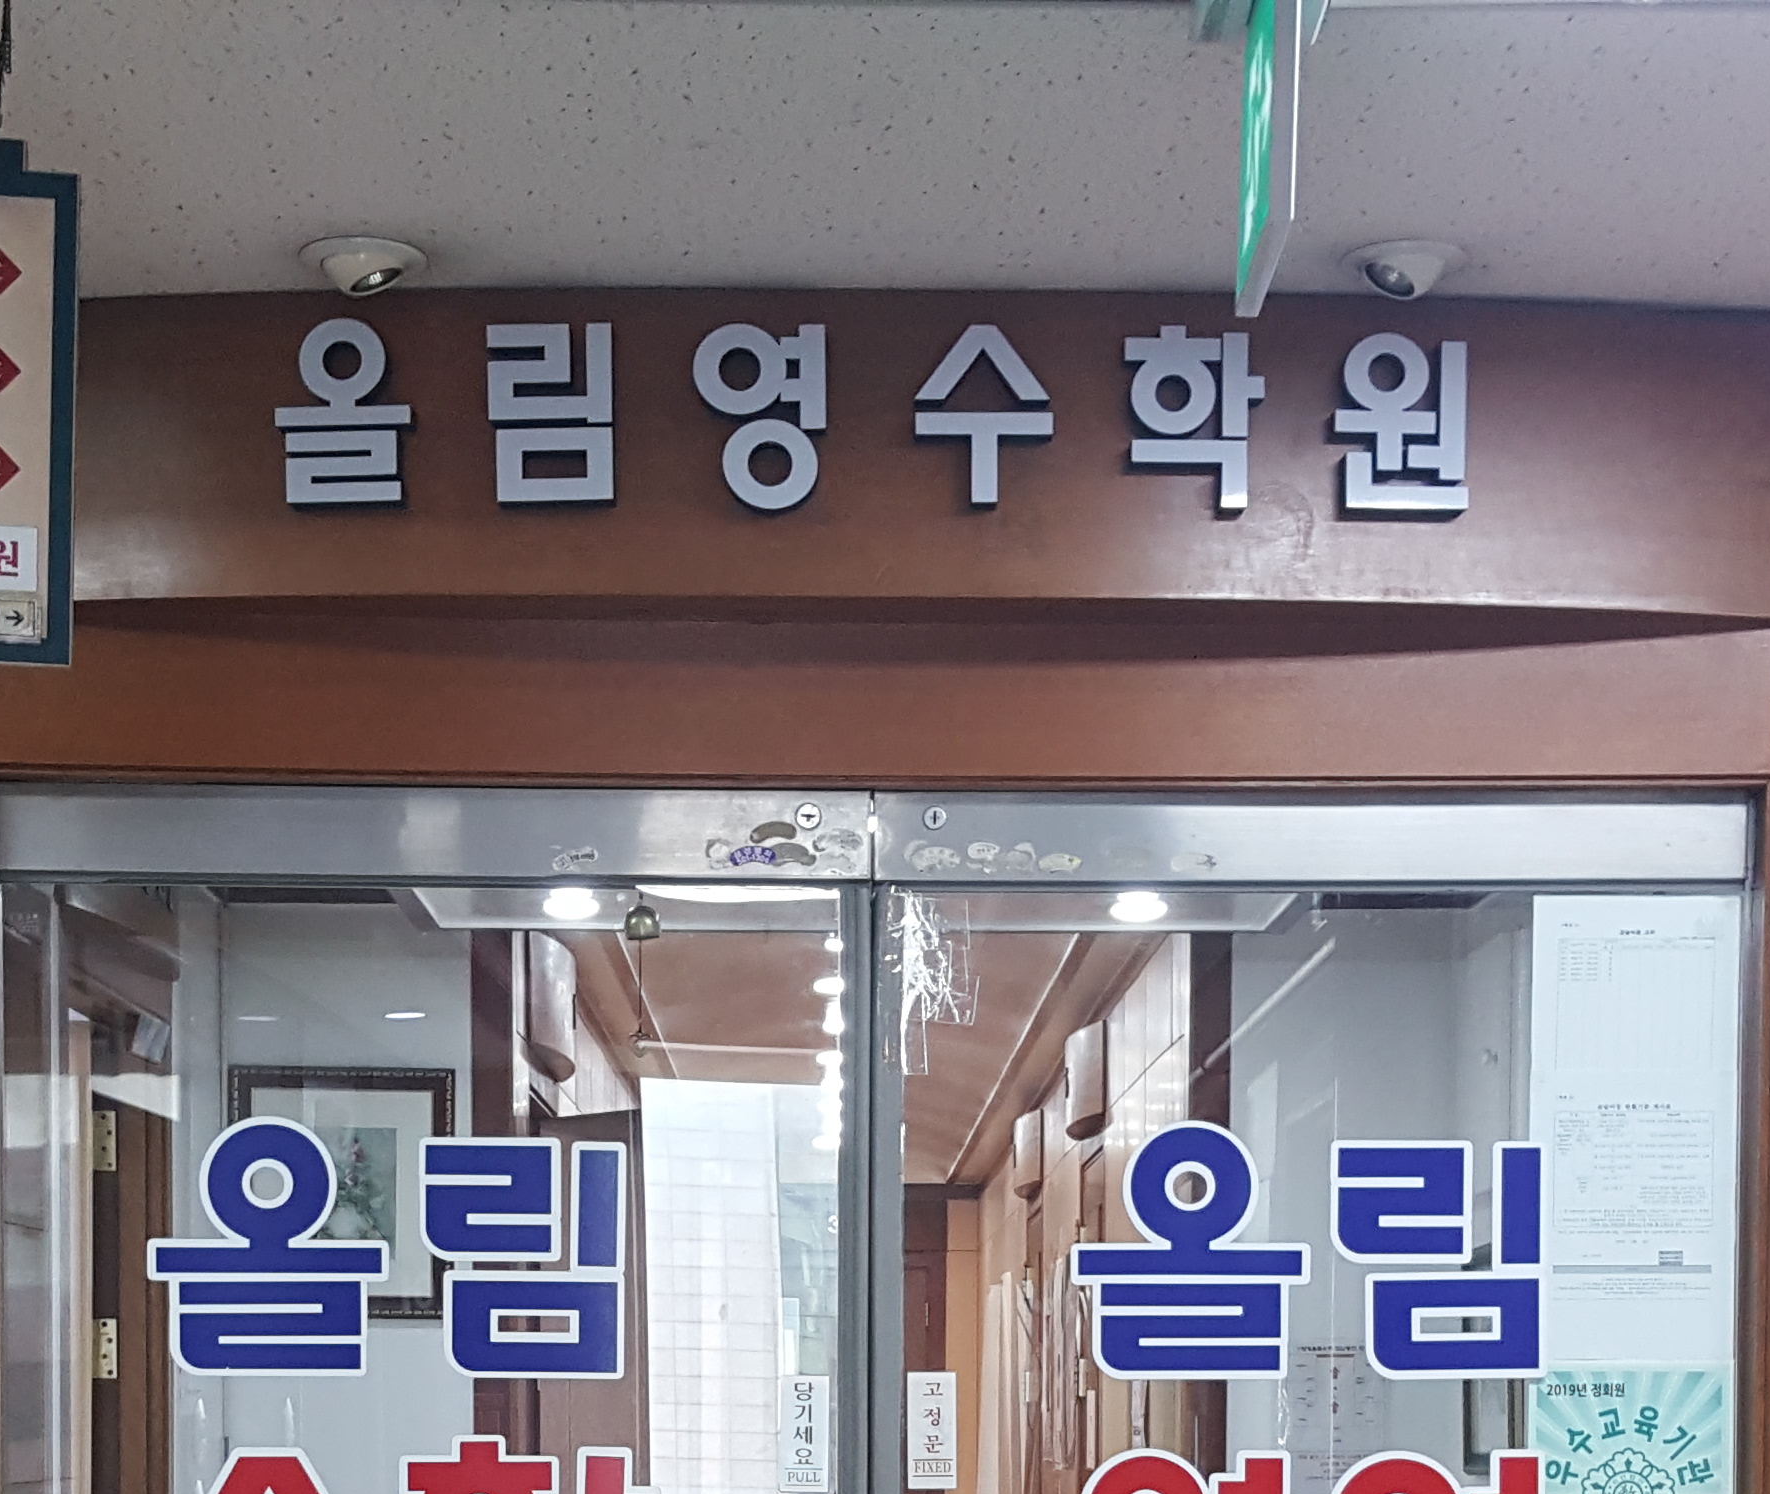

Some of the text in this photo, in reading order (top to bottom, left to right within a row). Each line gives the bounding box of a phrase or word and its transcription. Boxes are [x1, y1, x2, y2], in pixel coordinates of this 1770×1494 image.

[274, 318, 1469, 514] 올림영수학원
[147, 1115, 628, 1380] 올림
[1071, 1120, 1548, 1381] 올림
[793, 1382, 815, 1465] 당기세요
[922, 1382, 944, 1454] 고정문
[1547, 1383, 1625, 1398] 2019년 정회원
[787, 1471, 821, 1483] PULL
[914, 1461, 952, 1474] FIXED
